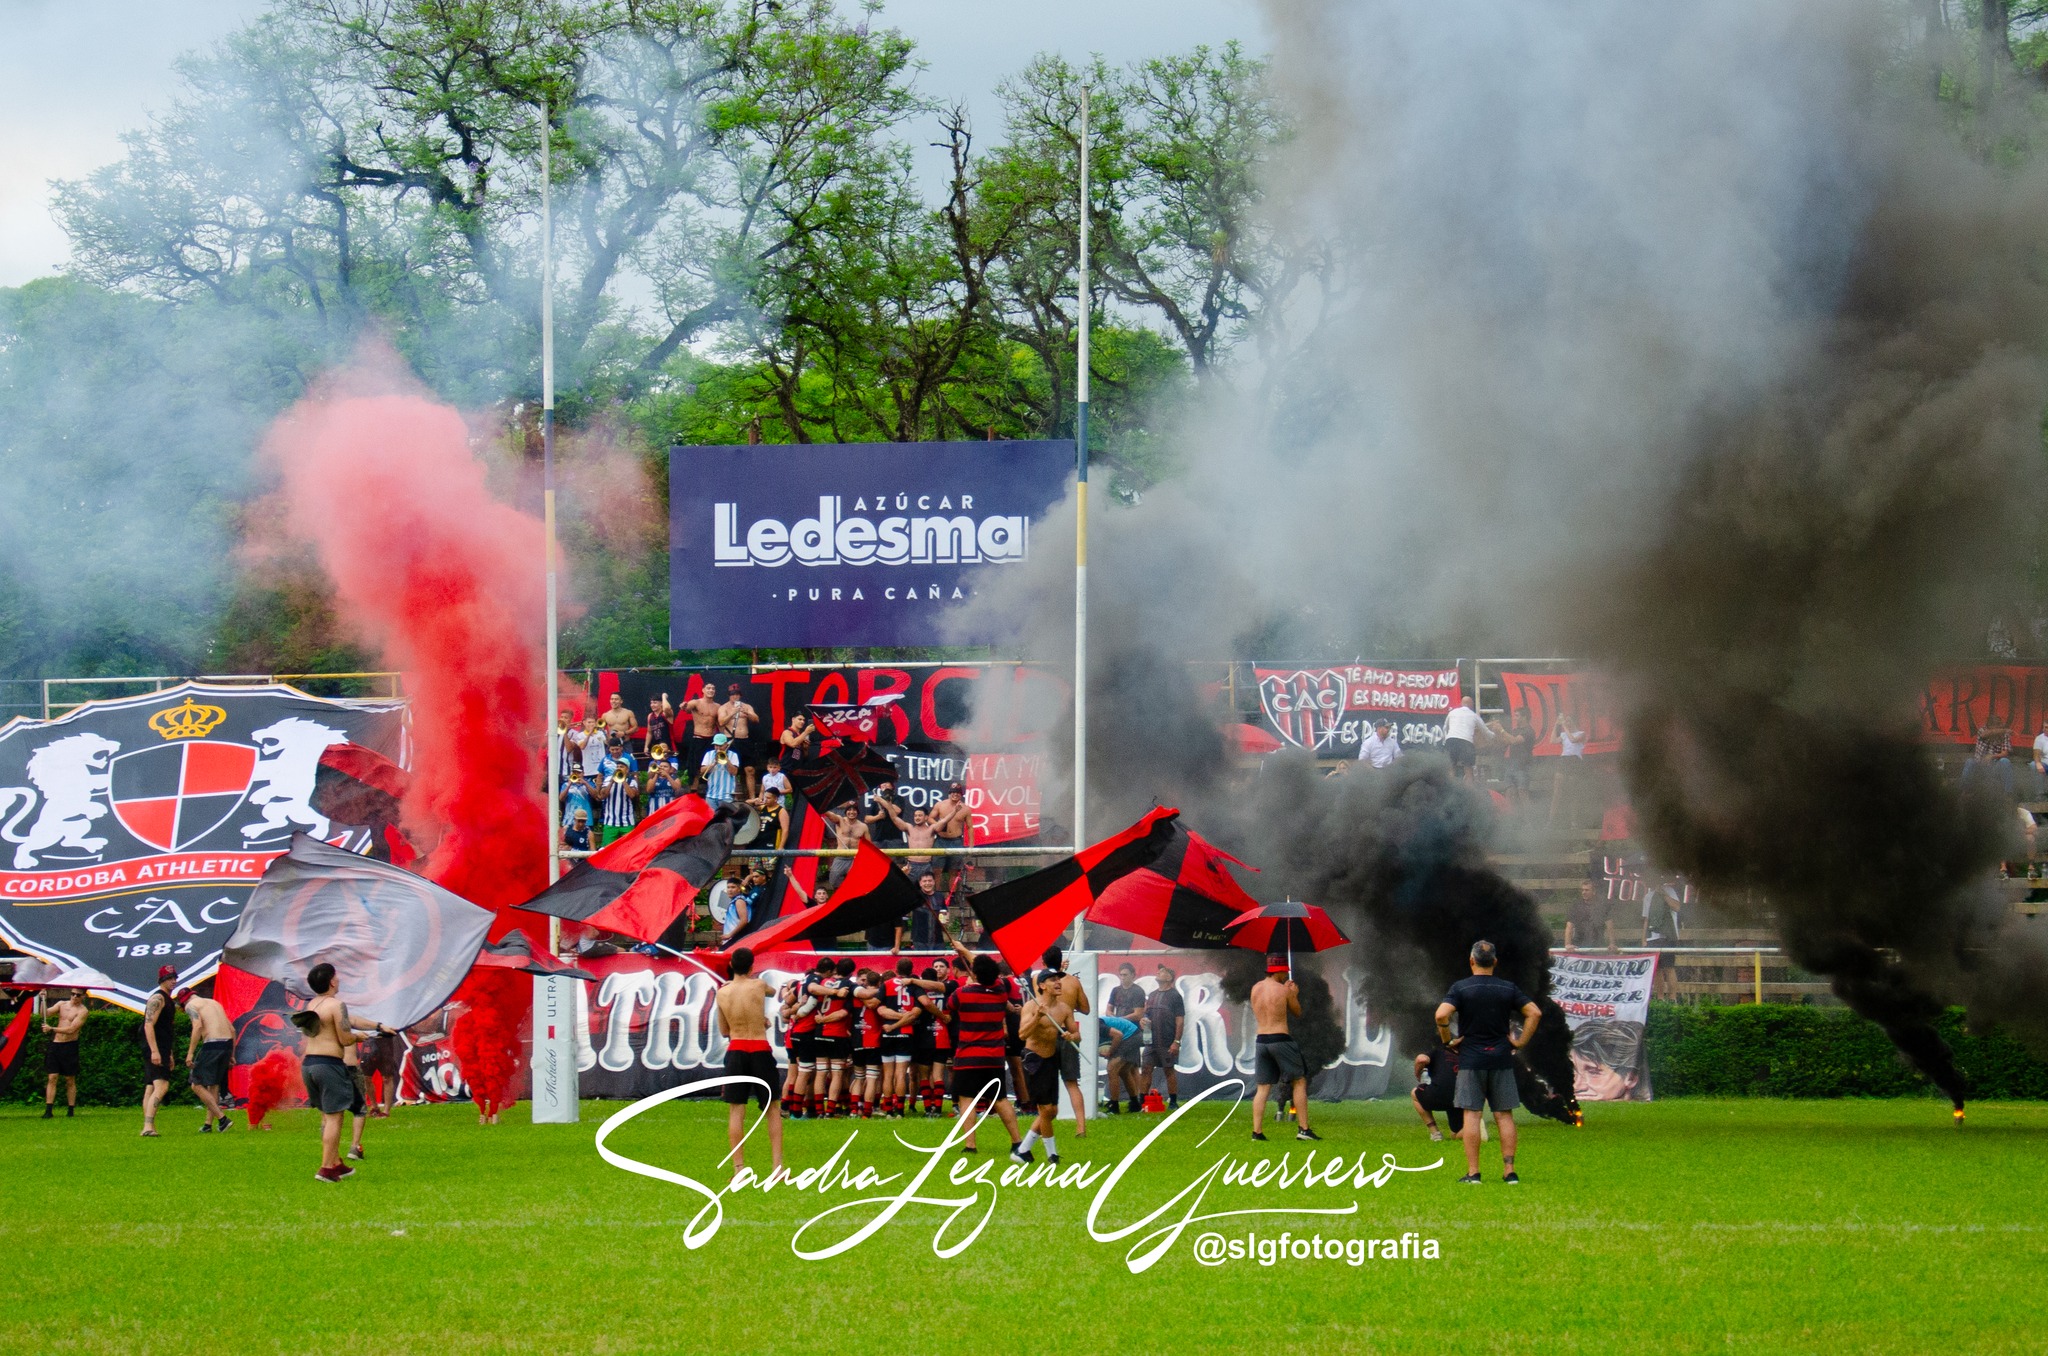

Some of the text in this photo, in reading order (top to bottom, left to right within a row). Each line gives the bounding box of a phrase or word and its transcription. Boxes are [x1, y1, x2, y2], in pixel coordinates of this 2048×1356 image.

[854, 491, 975, 511] AZÚCAR
[714, 495, 1029, 567] Ledesma
[788, 583, 964, 601] PURA CAÑA
[1345, 667, 1459, 689] TE AMO PERO NO
[1272, 689, 1338, 713] CAC
[1353, 690, 1369, 706] ES
[1371, 690, 1408, 709] PARA
[1341, 720, 1359, 744] ES
[904, 755, 954, 781] TEMO
[5, 868, 127, 893] CORDOBA
[137, 858, 255, 879] ATHLETIC
[116, 941, 193, 958] 1882
[547, 976, 557, 1018] ULTRA
[895, 983, 911, 1006] 15
[544, 1047, 558, 1108] Michelob
